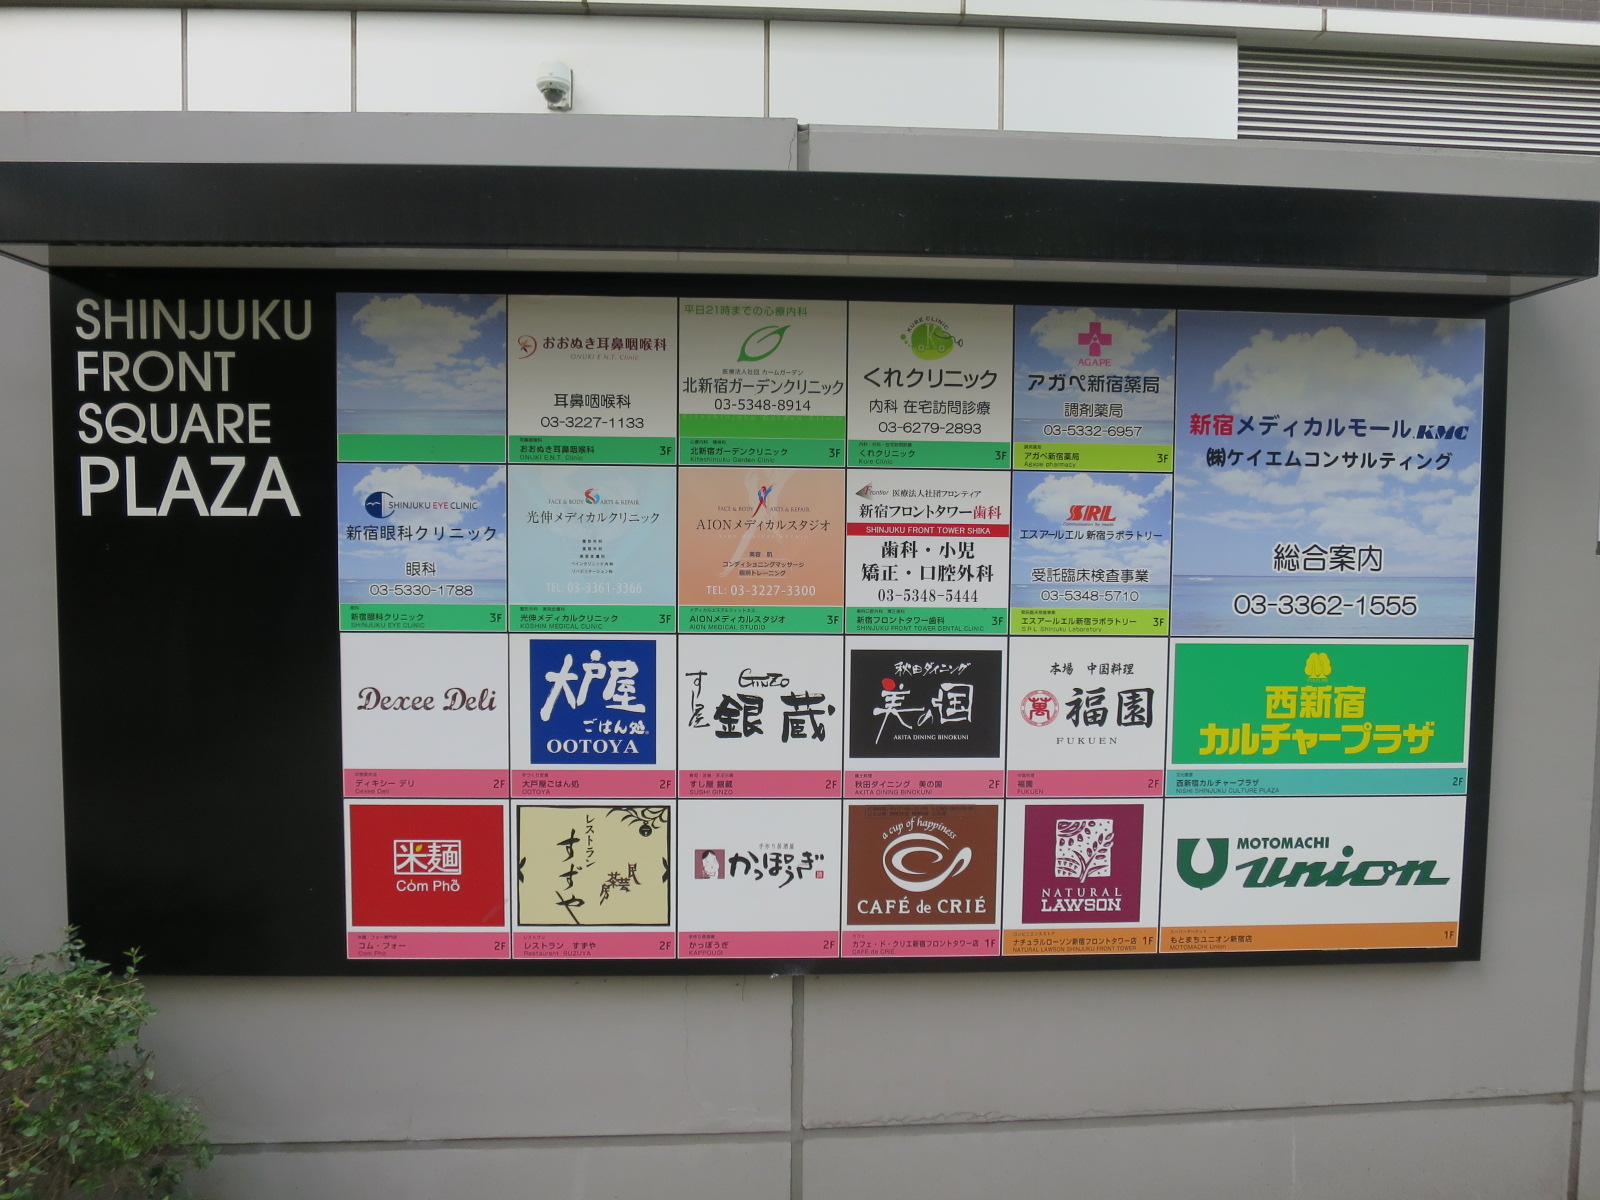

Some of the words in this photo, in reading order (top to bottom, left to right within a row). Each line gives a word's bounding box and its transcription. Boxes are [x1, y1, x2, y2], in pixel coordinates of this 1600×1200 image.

[685, 305, 807, 317] 平日21時までの心療内科
[75, 299, 312, 340] SHINJUKU
[907, 318, 923, 333] KURE
[926, 316, 949, 330] CLINIC
[543, 337, 666, 351] おおぬき耳鼻咽喉科
[1078, 358, 1111, 366] AGAPE
[77, 351, 236, 392] FRONT
[864, 368, 997, 389] くれクリニック
[1028, 374, 1160, 394] アガペ新宿薬局
[683, 377, 844, 395] 北新宿ガーデンクリニック
[554, 394, 631, 408] 耳鼻咽喉科
[715, 399, 811, 411] 03-5348-8914
[869, 399, 897, 413] 内科
[904, 400, 991, 415] 在宅訪問診療
[1064, 403, 1123, 418] 調剤薬局
[78, 403, 271, 444] SQUARE
[540, 417, 644, 428] 03-3227-1133
[878, 422, 981, 434] 03-6279-2893
[1044, 425, 1142, 437] 03-5332-6957
[520, 445, 594, 454] おおぬき耳鼻咽喉科
[660, 446, 672, 455] 3F
[690, 447, 788, 456] 北新宿ガーデンクリニック
[829, 448, 841, 457] 3F
[859, 450, 915, 458] くれクリニック
[995, 451, 1006, 460] 3F
[1157, 454, 1168, 462] 3F
[80, 456, 301, 516] PLAZA
[527, 511, 660, 524] 光伸メディカルクリニック
[859, 504, 1001, 519] 新宿フロントタワー歯科
[1066, 505, 1117, 521] SRL
[696, 519, 830, 531] AIONメディカルスタジオ
[346, 525, 496, 541] 新宿眼科クリニック
[1020, 530, 1083, 540] エスアールエル
[1086, 531, 1162, 541] 新宿ラボラトリー
[881, 541, 975, 559] 歯科・小児
[1273, 543, 1383, 572] 総合案内
[406, 562, 436, 576] 眼科
[861, 564, 993, 582] 矯正・口腔外科
[1032, 568, 1149, 583] 受託臨床検査事業
[370, 585, 473, 596] 03-5330-1788
[568, 583, 642, 594] 03-3361-3366
[707, 586, 727, 595] TEL:
[731, 585, 816, 596] 03-3227-3300
[878, 588, 978, 602] 03-5348-5444
[1041, 590, 1139, 602] 03-5348-5710
[1234, 594, 1417, 616] 03-3362-1555
[351, 613, 424, 621] 新宿眼科クリニック
[490, 613, 502, 622] 3F
[520, 614, 618, 622] 光伸メディカルクリニック
[659, 615, 671, 624] 3F
[690, 615, 785, 624] AIONメディカルスタジオ
[827, 616, 839, 624] 3F
[857, 616, 945, 624] 新宿フロントタワー歯科
[992, 617, 1003, 625] 3F
[1021, 617, 1136, 625] エスアールエル新宿ラボラトリー
[1153, 618, 1164, 626] 3F
[894, 661, 971, 676] 秋田ダイニング
[1050, 662, 1074, 675] 本場
[1087, 663, 1134, 675] 中国料理
[540, 650, 646, 721] 大戸屋
[357, 687, 435, 711] Dexee
[442, 687, 496, 711] Deli
[1265, 685, 1366, 719] 西新宿
[873, 678, 974, 744] 美の国
[1065, 687, 1155, 728] 福園
[583, 718, 646, 734] ごはん処
[1056, 737, 1118, 745] FUKUEN
[1199, 722, 1435, 755] カルチャープラザ
[547, 739, 639, 754] OOTOYA
[494, 780, 505, 789] 2F
[522, 780, 579, 788] 大戸屋ごはん処
[660, 780, 671, 789] 2F
[826, 780, 837, 789] 2F
[988, 780, 1000, 789] 2F
[1148, 779, 1159, 788] 2F
[1176, 778, 1260, 787] 西新宿カルチャープラザ
[1452, 777, 1463, 786] 2F
[889, 823, 904, 835] cup
[906, 817, 915, 831] of
[917, 816, 957, 839] happiness
[585, 814, 595, 868] レストラン
[1237, 837, 1329, 849] MOTOMACHI
[1236, 845, 1450, 888] union
[555, 828, 585, 924] すずや
[1042, 888, 1122, 897] NATURAL
[857, 896, 910, 914] CAFÉ
[916, 900, 931, 913] de
[937, 896, 986, 913] CRIÉ
[1041, 898, 1121, 912] LAWSON
[1143, 937, 1154, 945] 1F
[1170, 935, 1253, 943] もとまちユニオン新宿店
[1444, 931, 1454, 939] 1F
[494, 942, 506, 950] 2F
[659, 941, 671, 950] 2F
[823, 941, 835, 949] 2F
[985, 939, 996, 947] 1F
